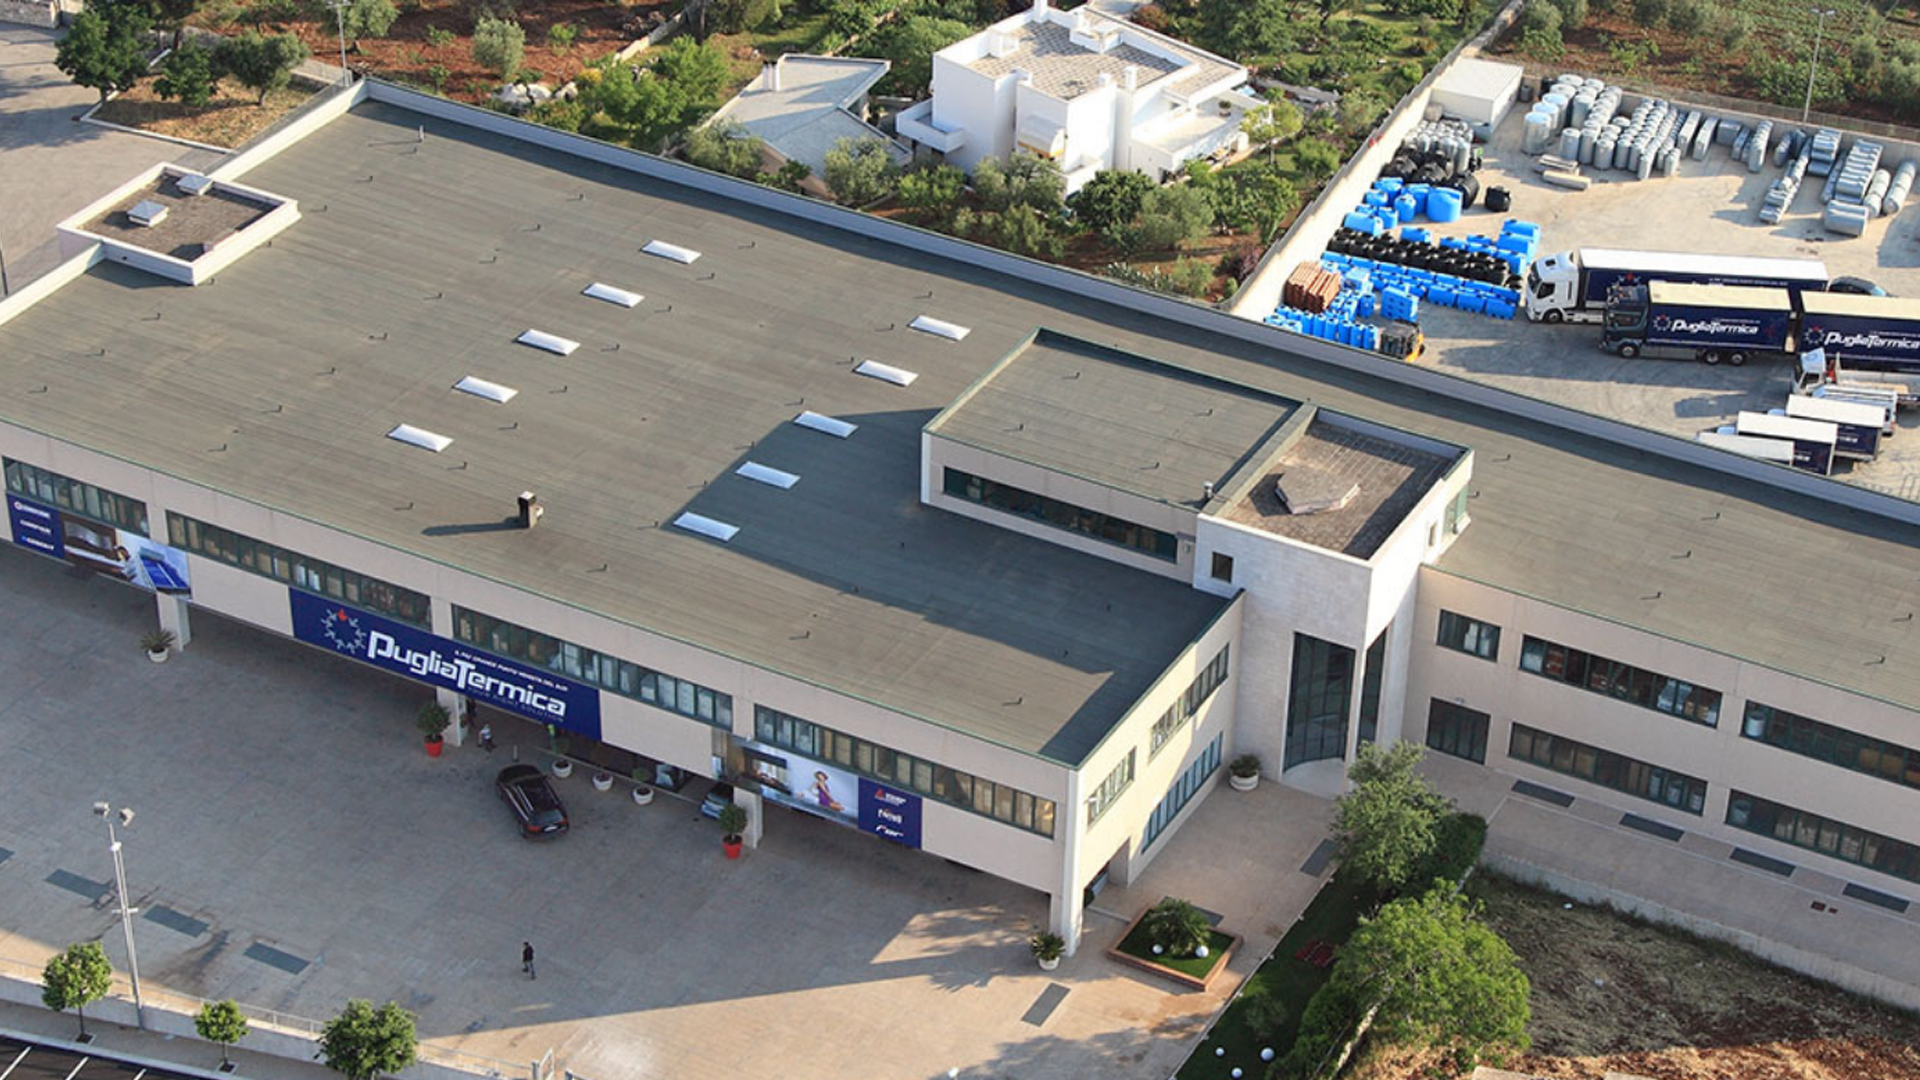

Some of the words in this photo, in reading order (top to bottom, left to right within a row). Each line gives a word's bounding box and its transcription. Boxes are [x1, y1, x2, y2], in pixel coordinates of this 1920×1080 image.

[1671, 319, 1758, 335] PugliaTermica
[1824, 331, 1920, 349] PugliaTermica
[368, 630, 566, 717] PugliaTermica
